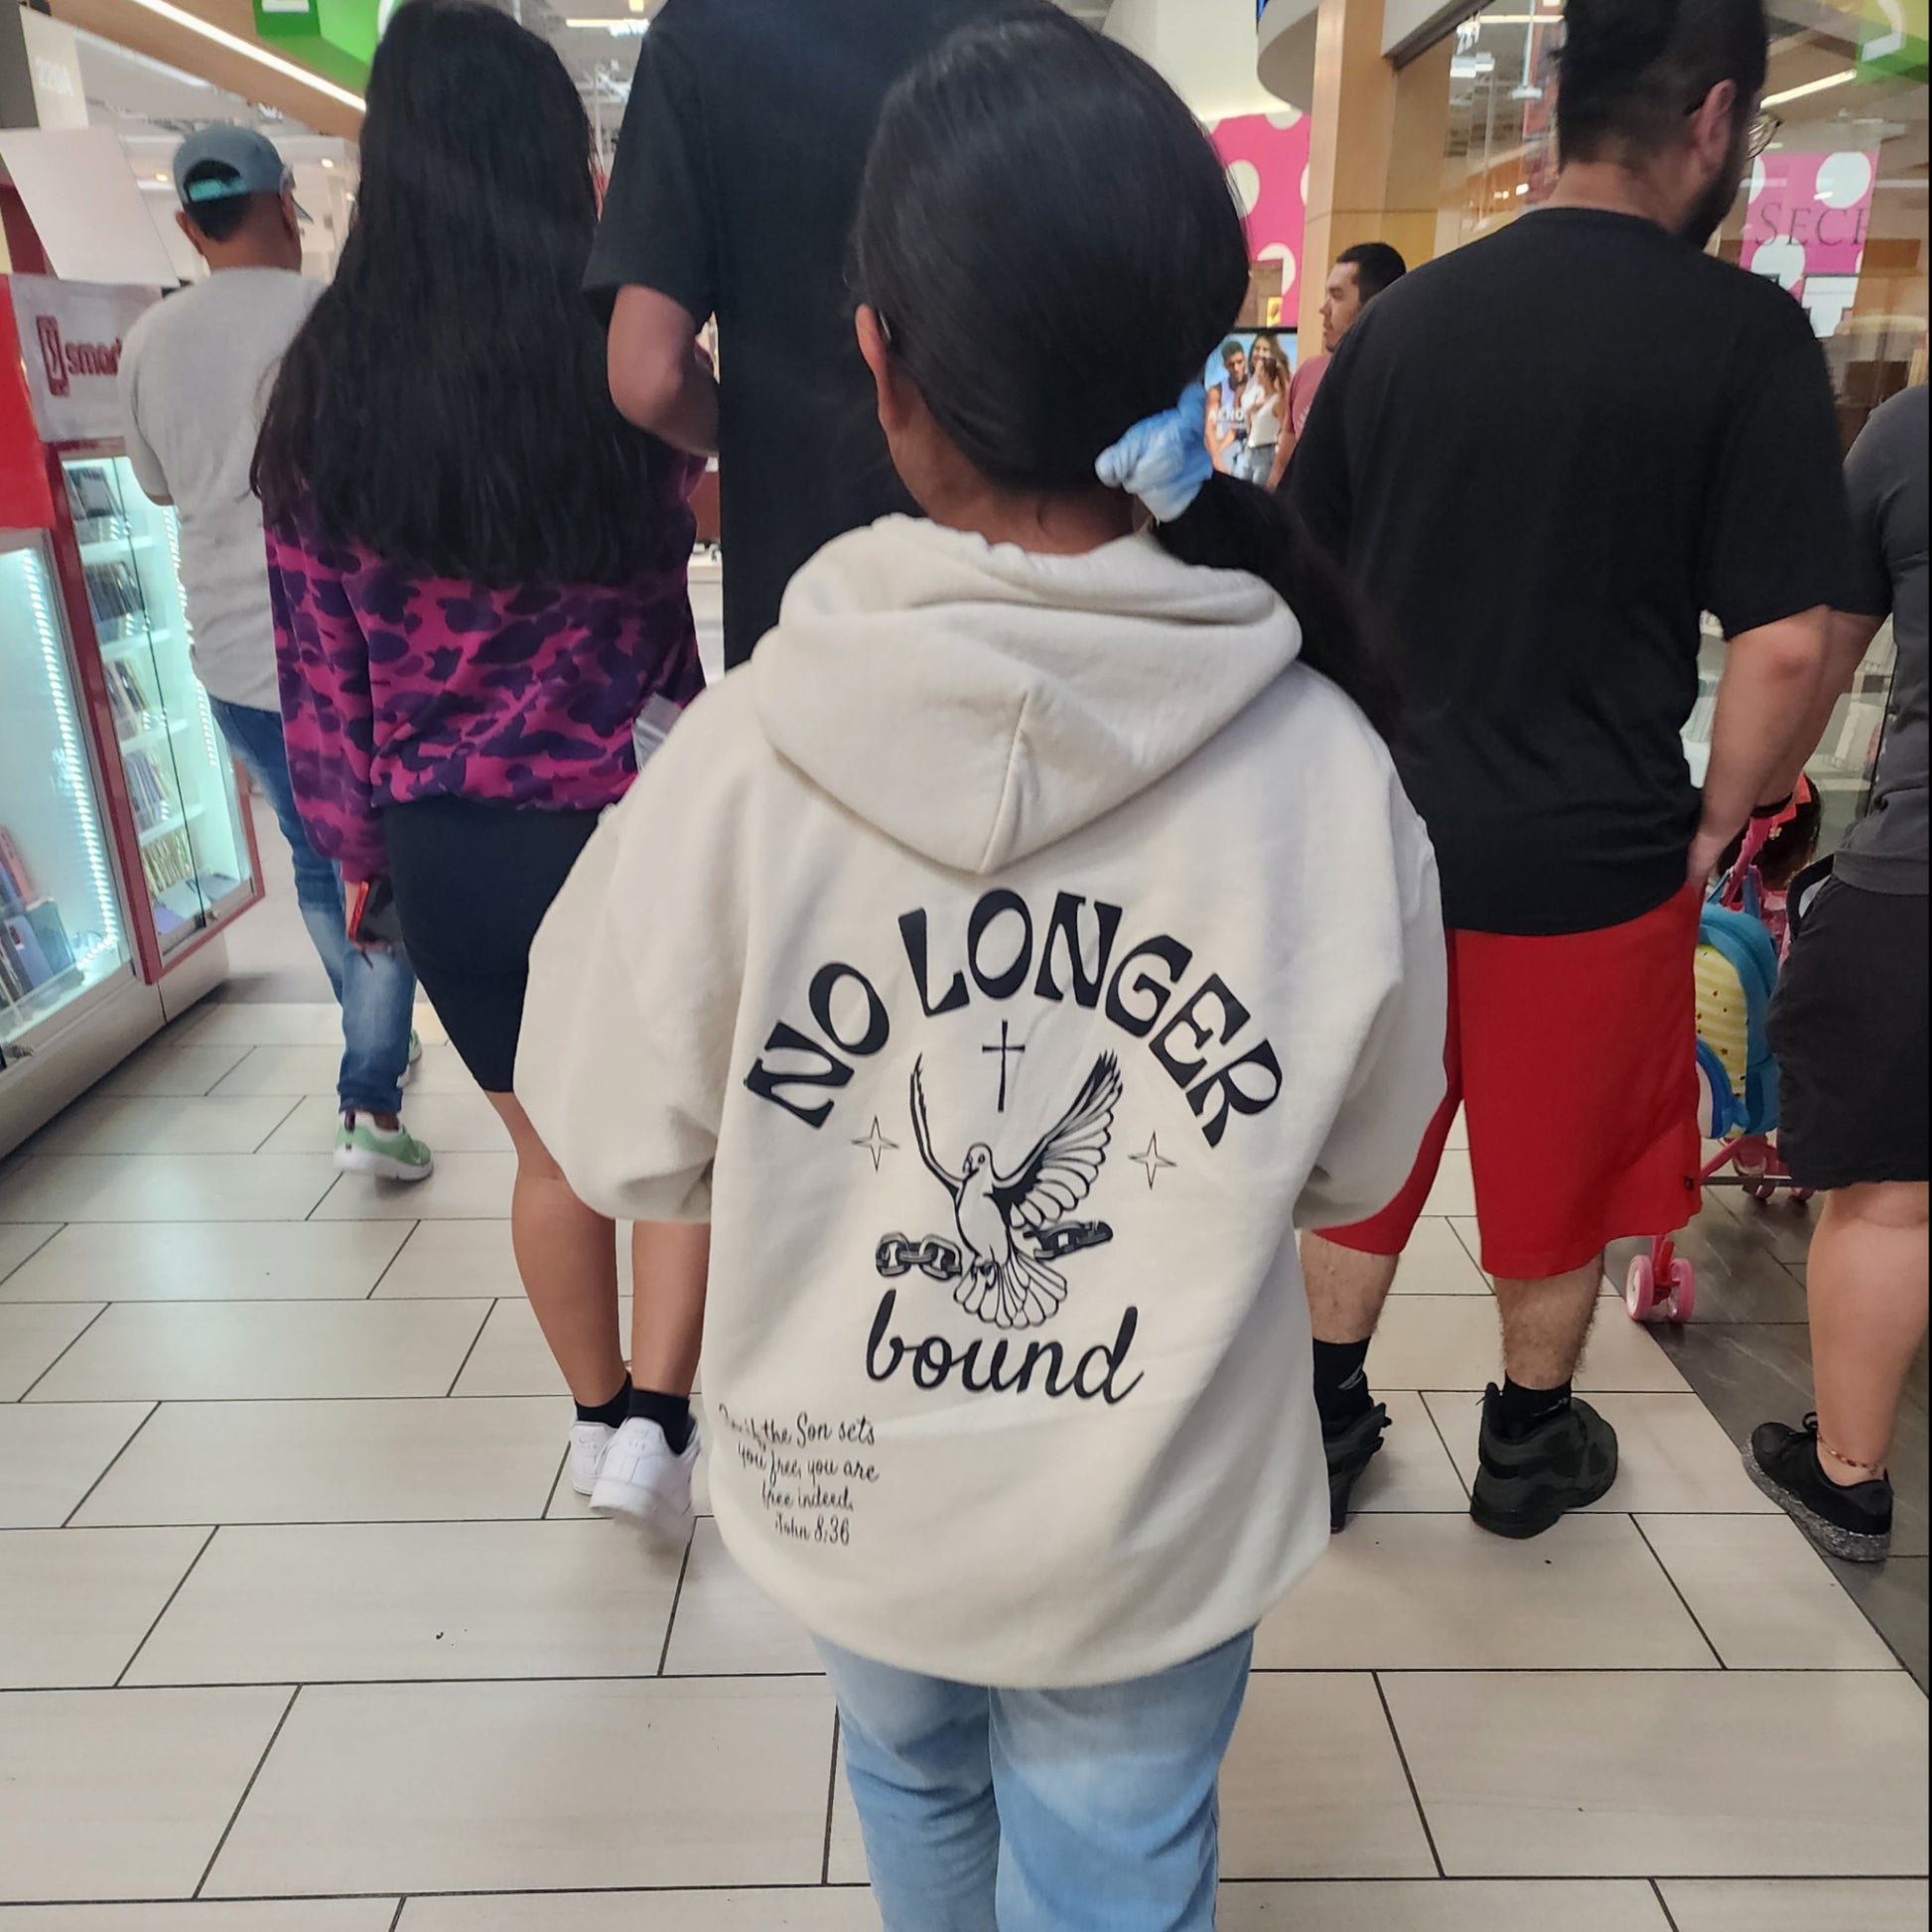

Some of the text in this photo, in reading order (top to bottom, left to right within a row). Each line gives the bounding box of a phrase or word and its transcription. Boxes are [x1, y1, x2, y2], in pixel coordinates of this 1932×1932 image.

[744, 888, 1283, 1149] NO LONGER
[866, 1289, 1145, 1405] bound
[762, 1419, 792, 1446] the
[796, 1411, 832, 1449] Son
[837, 1415, 875, 1446] sets
[807, 1459, 838, 1487] you
[843, 1459, 880, 1483] are
